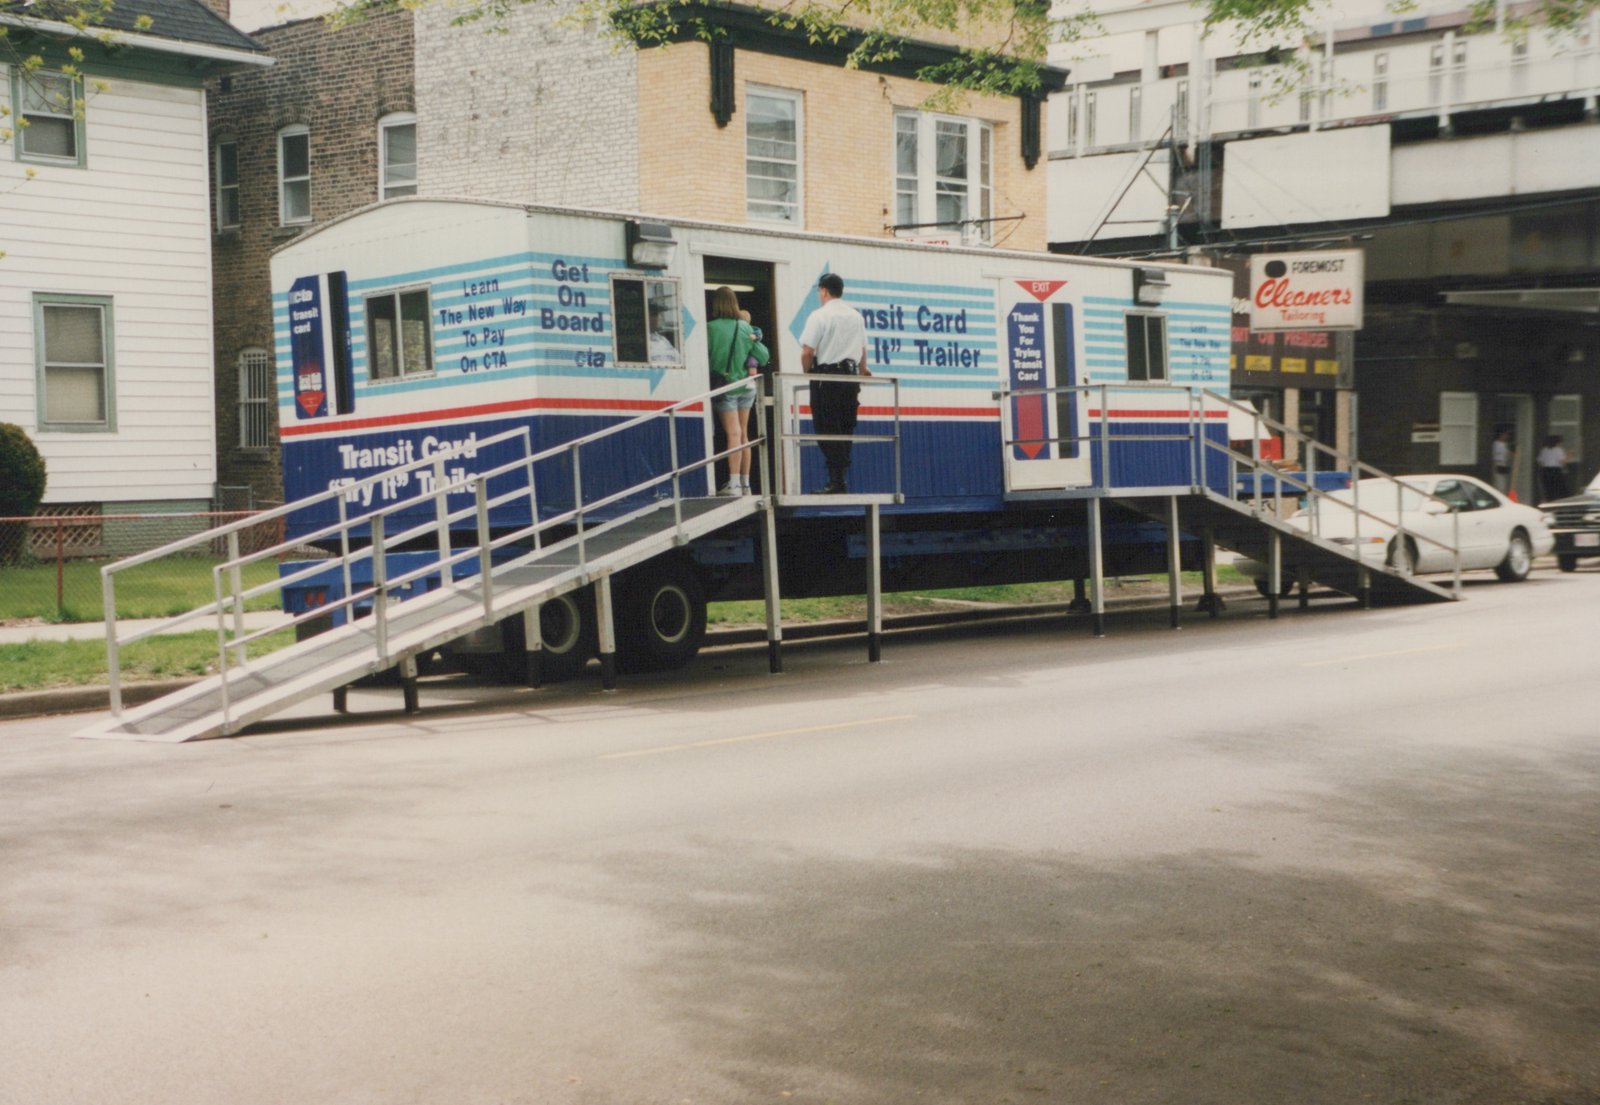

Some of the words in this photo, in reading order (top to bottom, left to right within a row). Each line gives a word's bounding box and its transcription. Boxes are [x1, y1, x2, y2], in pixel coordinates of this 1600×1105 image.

[552, 259, 589, 283] Get
[1292, 259, 1345, 274] FOREMOST
[463, 278, 499, 297] Learn
[558, 285, 586, 308] On
[1032, 281, 1050, 293] EXIT
[1255, 278, 1352, 309] Cleaners
[293, 307, 319, 321] transit
[440, 308, 462, 327] The
[468, 303, 495, 322] New
[502, 296, 527, 317] Way
[540, 307, 604, 333] Board
[917, 305, 967, 334] Card
[1012, 312, 1039, 322] Thank
[1280, 309, 1326, 325] Tailoring
[293, 321, 311, 335] card
[462, 329, 477, 348] To
[483, 326, 505, 346] Pay
[1018, 324, 1035, 334] You
[1019, 335, 1034, 346] For
[460, 356, 477, 374] On
[483, 350, 508, 370] CTA
[574, 347, 606, 367] cta
[914, 339, 981, 368] Trailer
[1013, 347, 1041, 359] Trying
[1013, 359, 1043, 369] Transit
[1017, 370, 1039, 381] Card
[338, 439, 414, 470] Transit
[421, 431, 478, 460] Card
